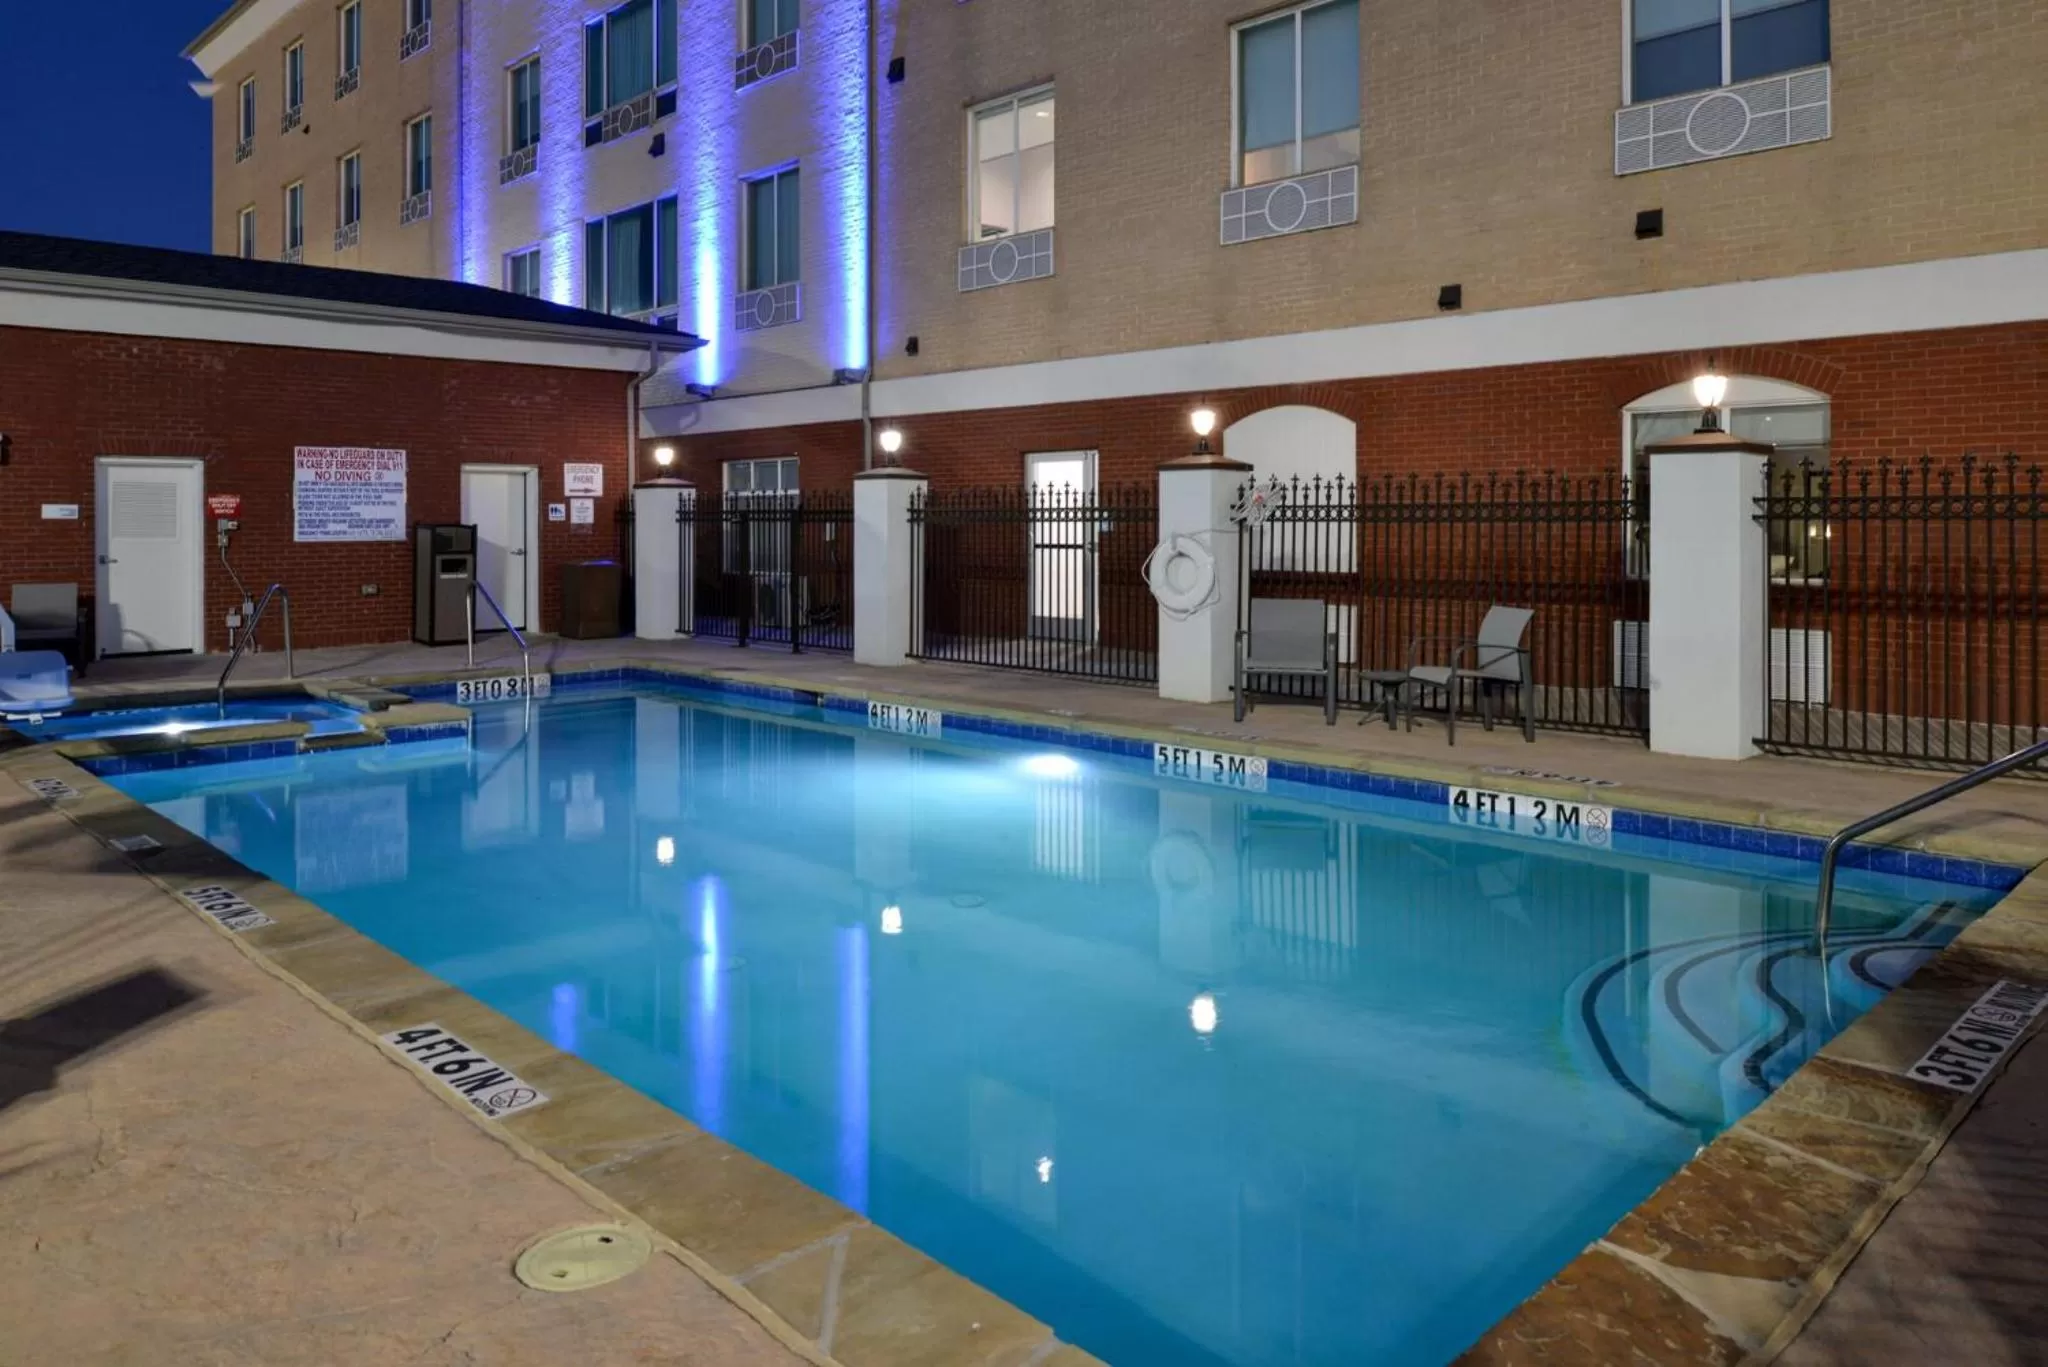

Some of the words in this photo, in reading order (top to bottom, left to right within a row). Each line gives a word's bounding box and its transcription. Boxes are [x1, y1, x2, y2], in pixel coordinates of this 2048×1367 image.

[387, 451, 403, 462] DUTY
[305, 460, 324, 470] CASE
[325, 460, 334, 470] OF
[335, 460, 375, 471] EMERGENCY
[376, 461, 392, 471] DIAL
[314, 471, 332, 481] NO
[334, 471, 372, 482] DIVING
